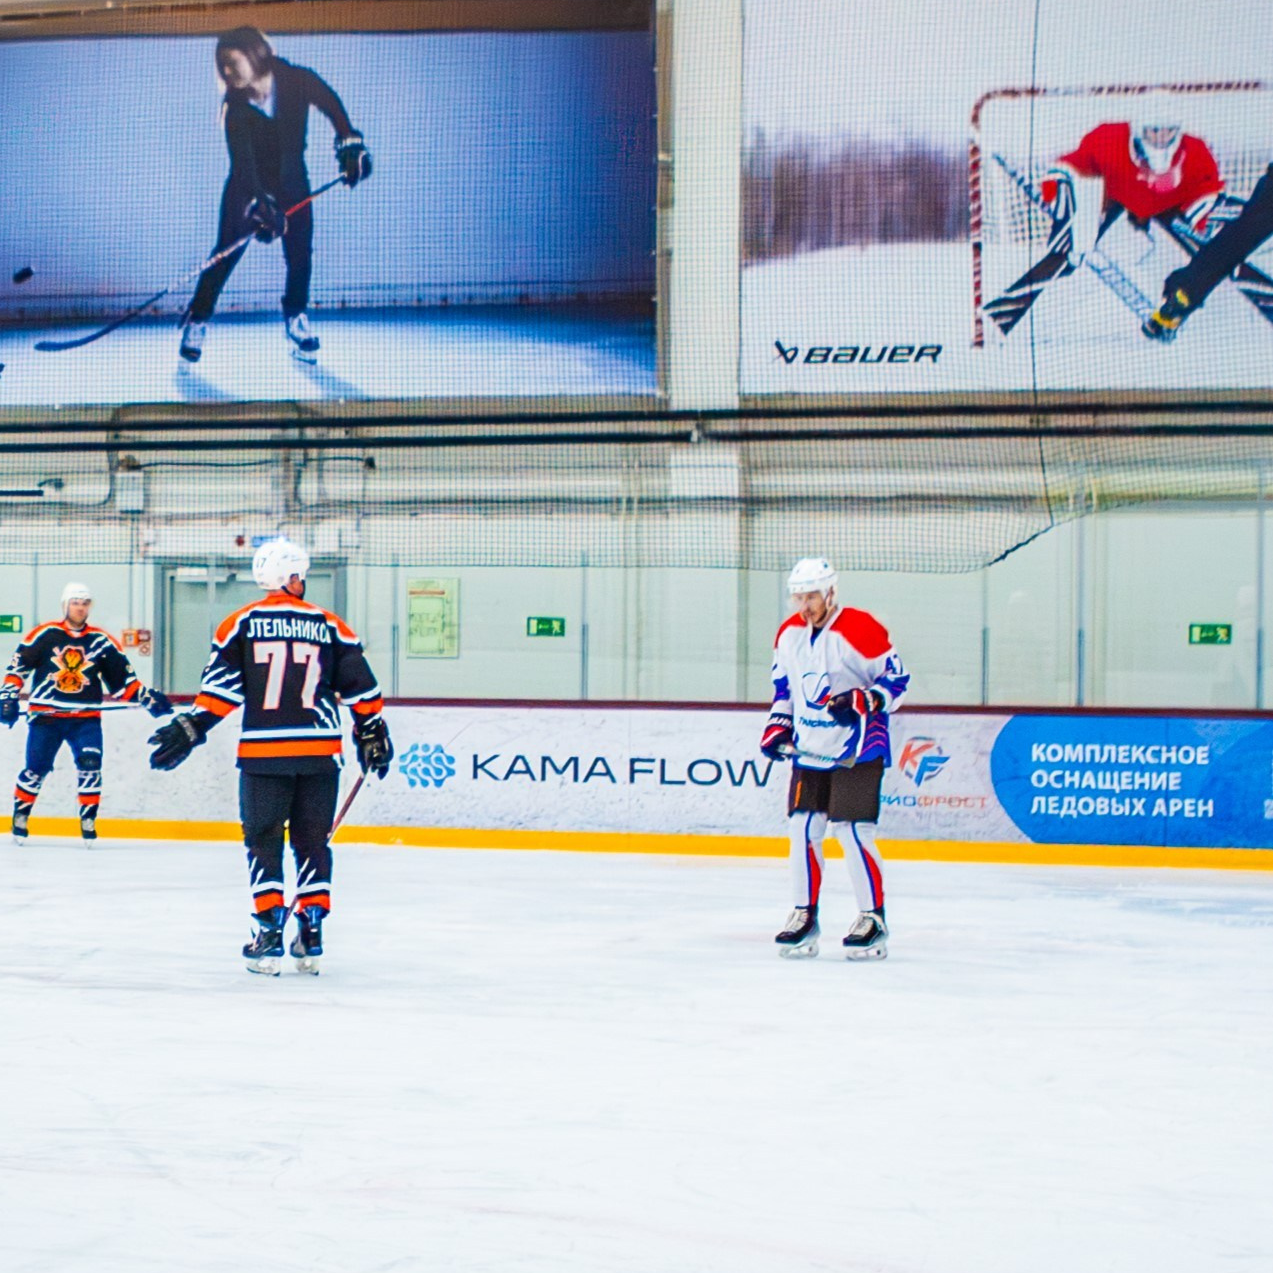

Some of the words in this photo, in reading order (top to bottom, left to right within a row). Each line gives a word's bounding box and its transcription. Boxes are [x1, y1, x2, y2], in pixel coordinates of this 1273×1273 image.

[803, 345, 943, 364] BAUER
[253, 641, 322, 710] 77
[1031, 743, 1210, 765] КОМПЛЕКСНОЕ
[471, 753, 616, 784] KAMA
[628, 757, 773, 787] FLOW
[1030, 769, 1182, 794] ОСНАЩЕНИЕ
[1030, 795, 1146, 818] ЛЕДОВЫХ
[1151, 798, 1215, 818] АРЕН
